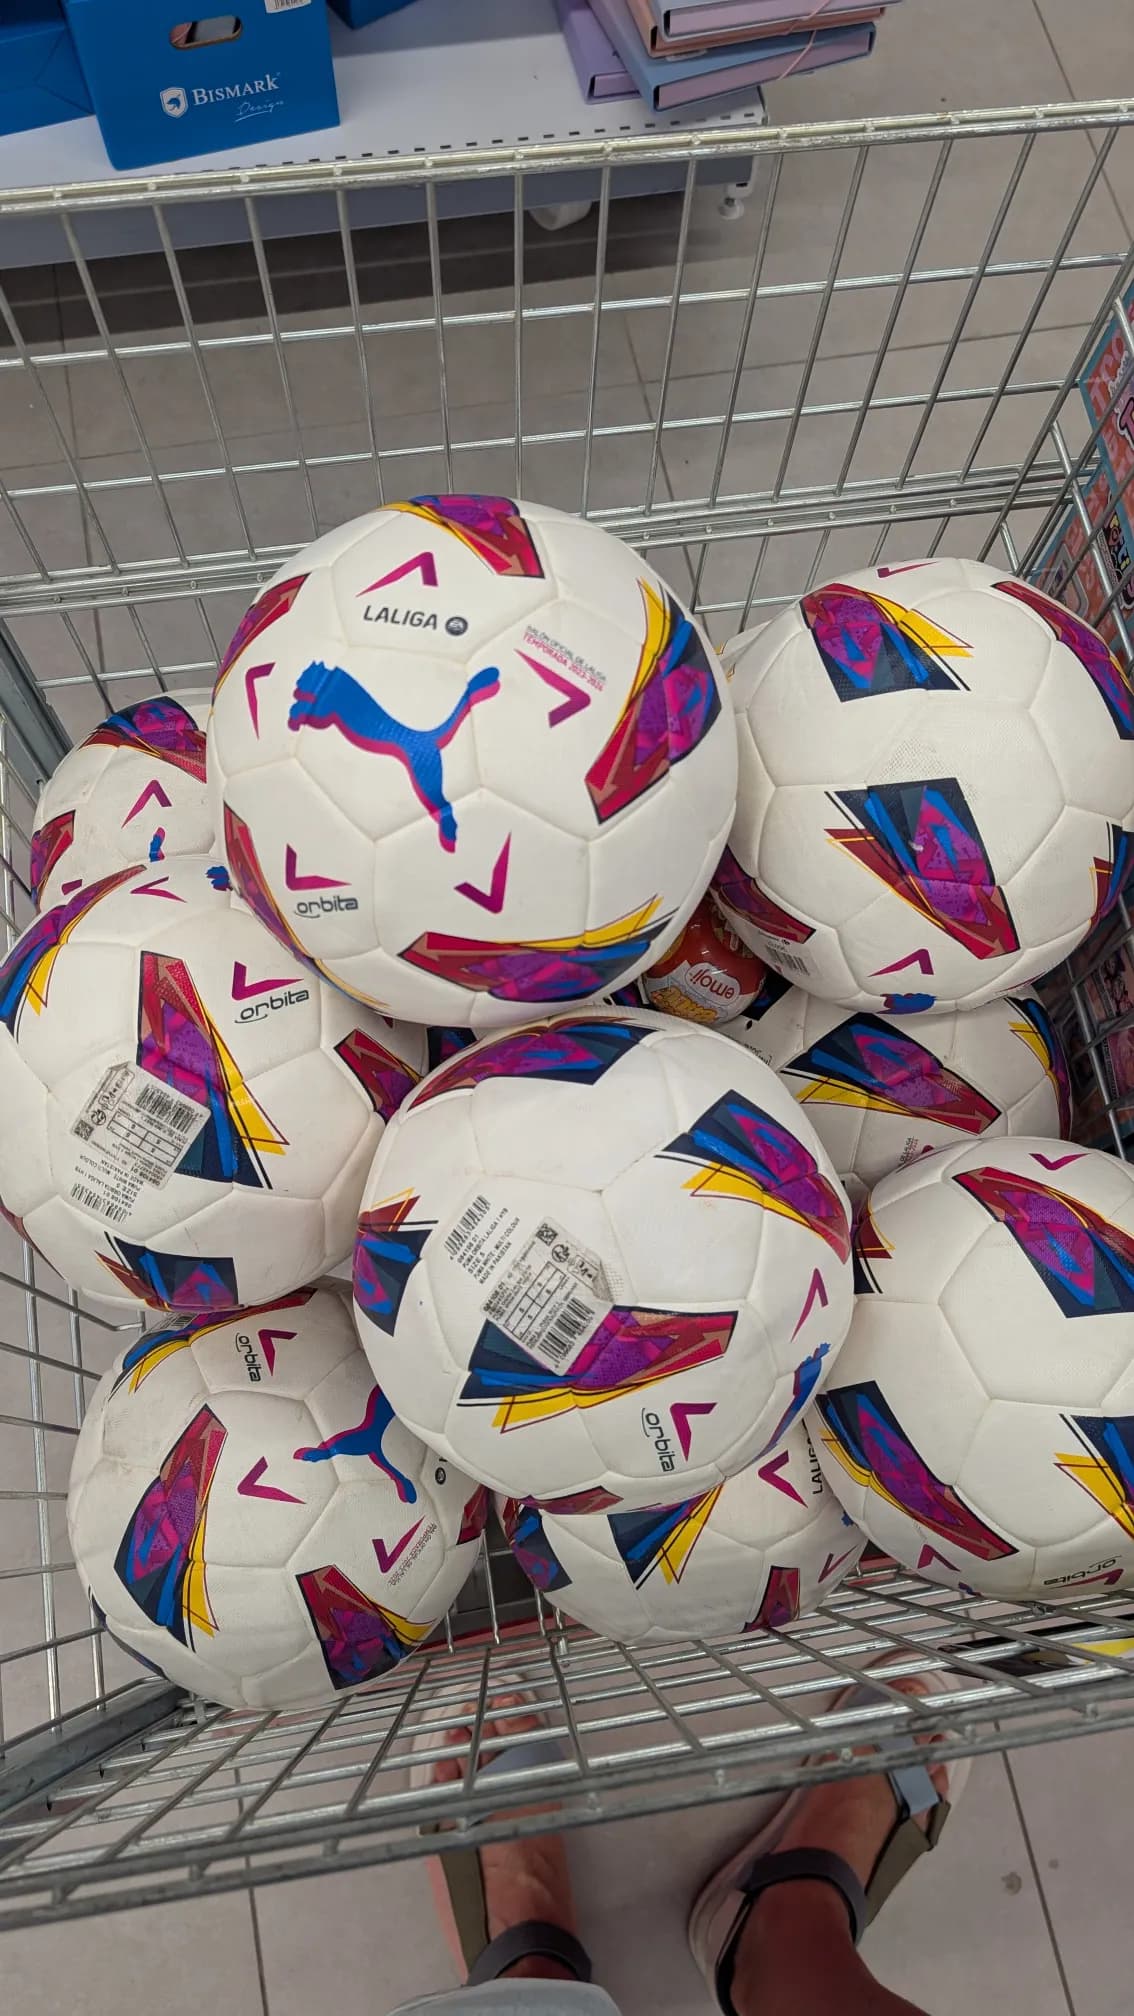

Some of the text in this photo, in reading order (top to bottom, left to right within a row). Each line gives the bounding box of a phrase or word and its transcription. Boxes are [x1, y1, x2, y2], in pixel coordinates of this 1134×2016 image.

[363, 605, 438, 630] LALIGA
[295, 895, 358, 916] orbita
[690, 969, 735, 999] emoji
[238, 990, 310, 1022] orbita
[237, 1335, 261, 1382] orbita
[644, 1411, 676, 1472] orbita
[806, 1438, 823, 1494] LALIG
[1044, 1558, 1117, 1585] orbita
